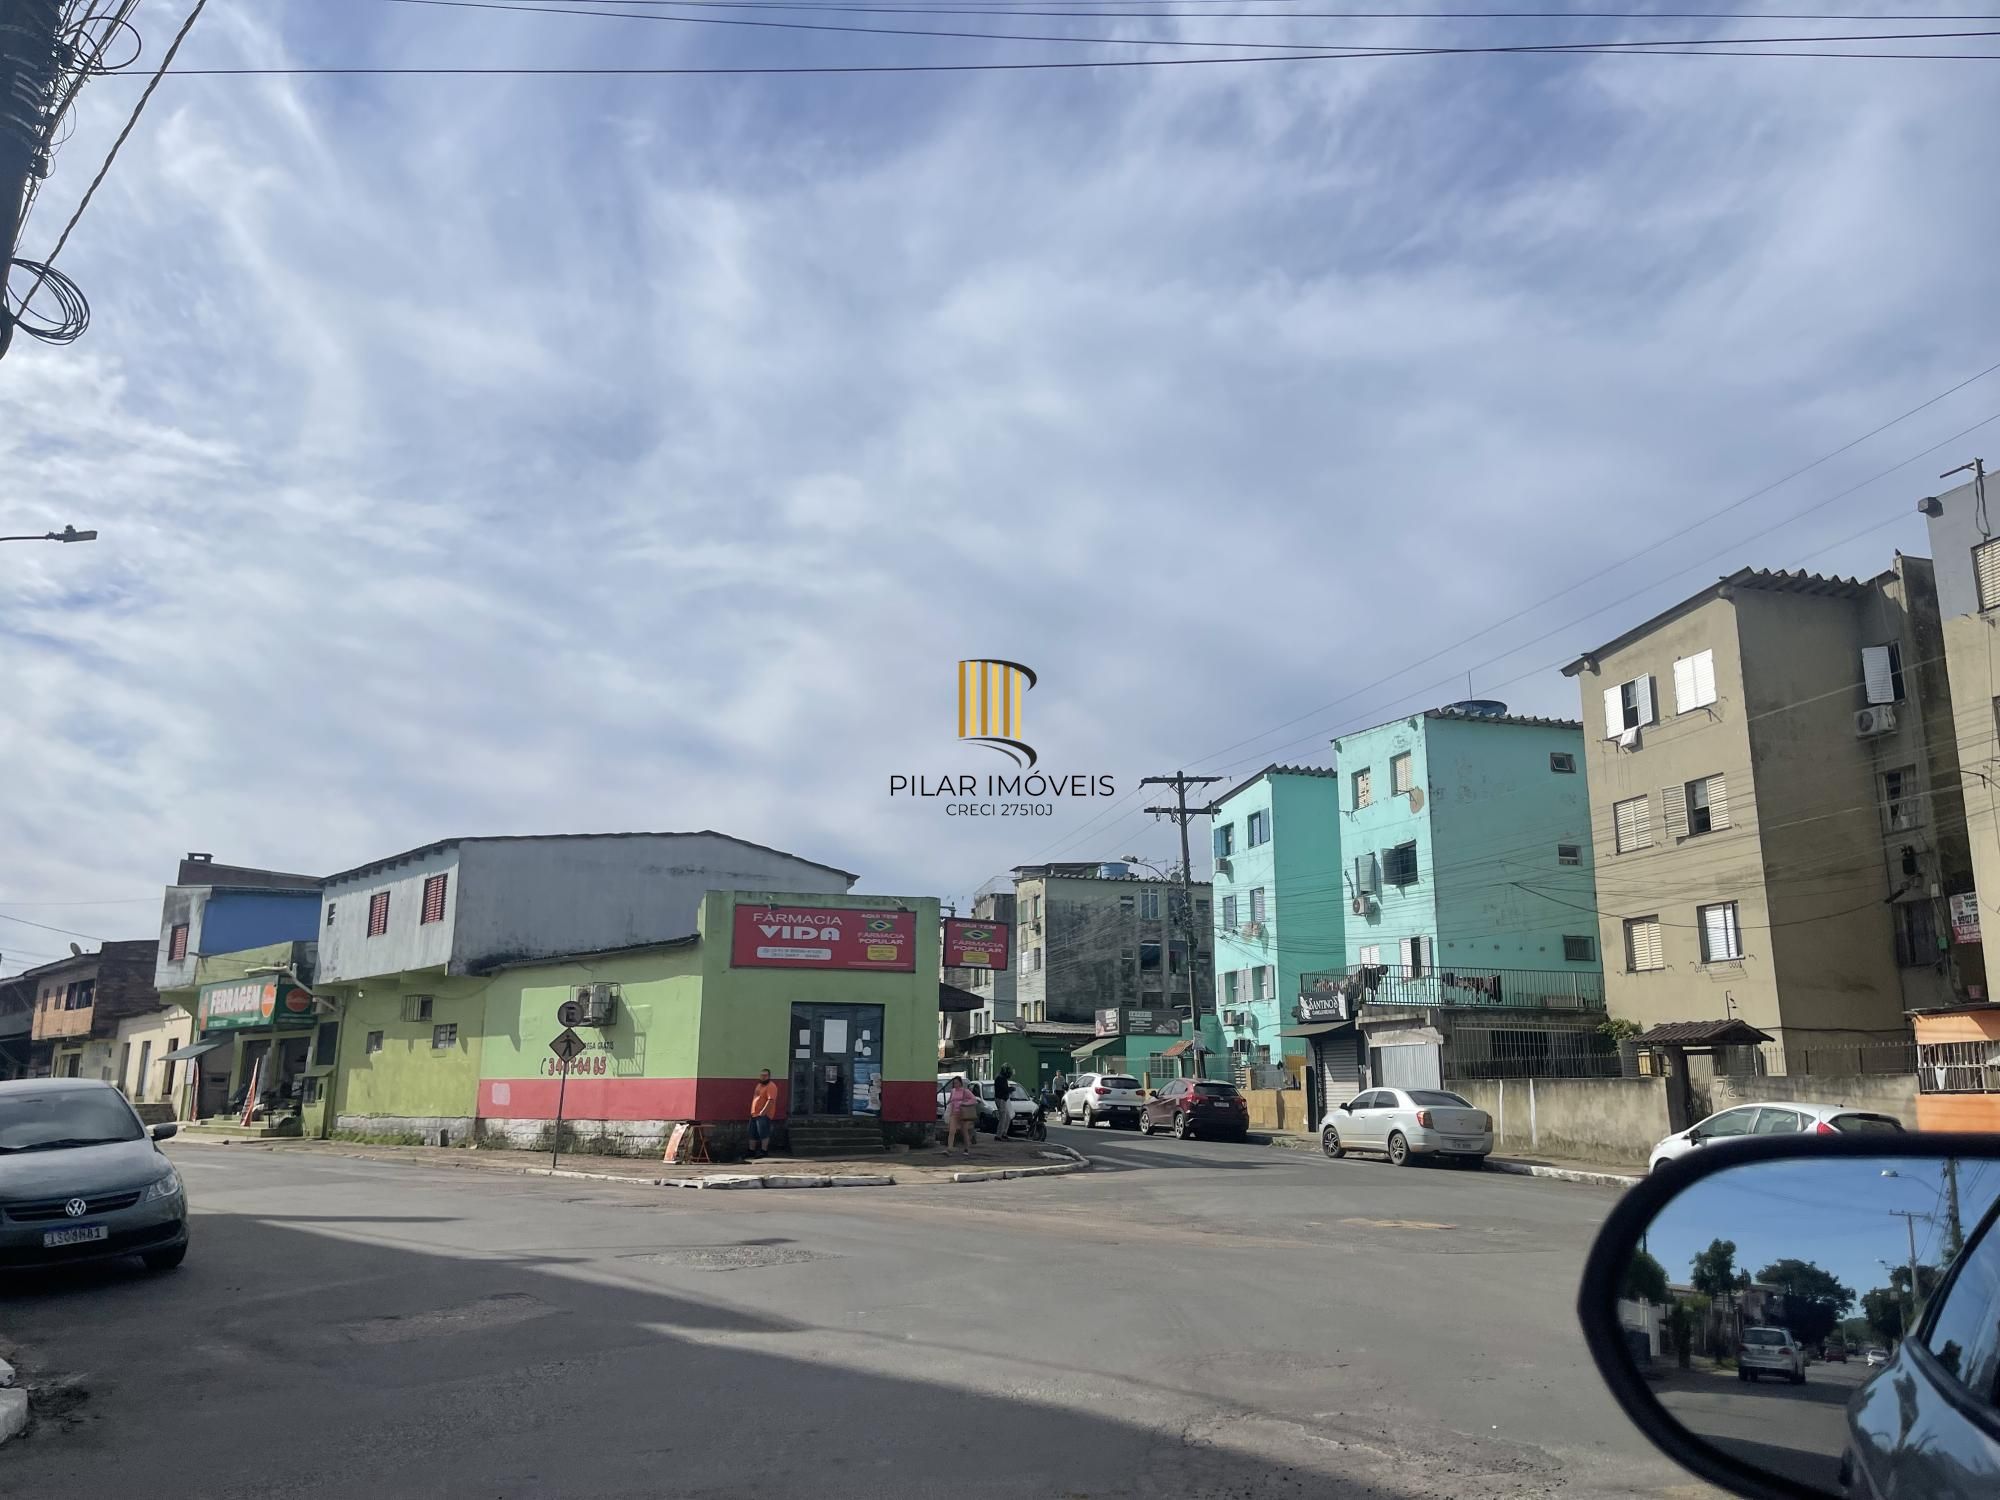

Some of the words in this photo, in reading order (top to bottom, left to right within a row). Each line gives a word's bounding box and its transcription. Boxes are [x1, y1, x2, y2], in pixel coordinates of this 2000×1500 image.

[758, 925, 841, 941] VIDA
[953, 945, 1003, 953] POPULAR
[210, 984, 261, 1015] FERRAGEM
